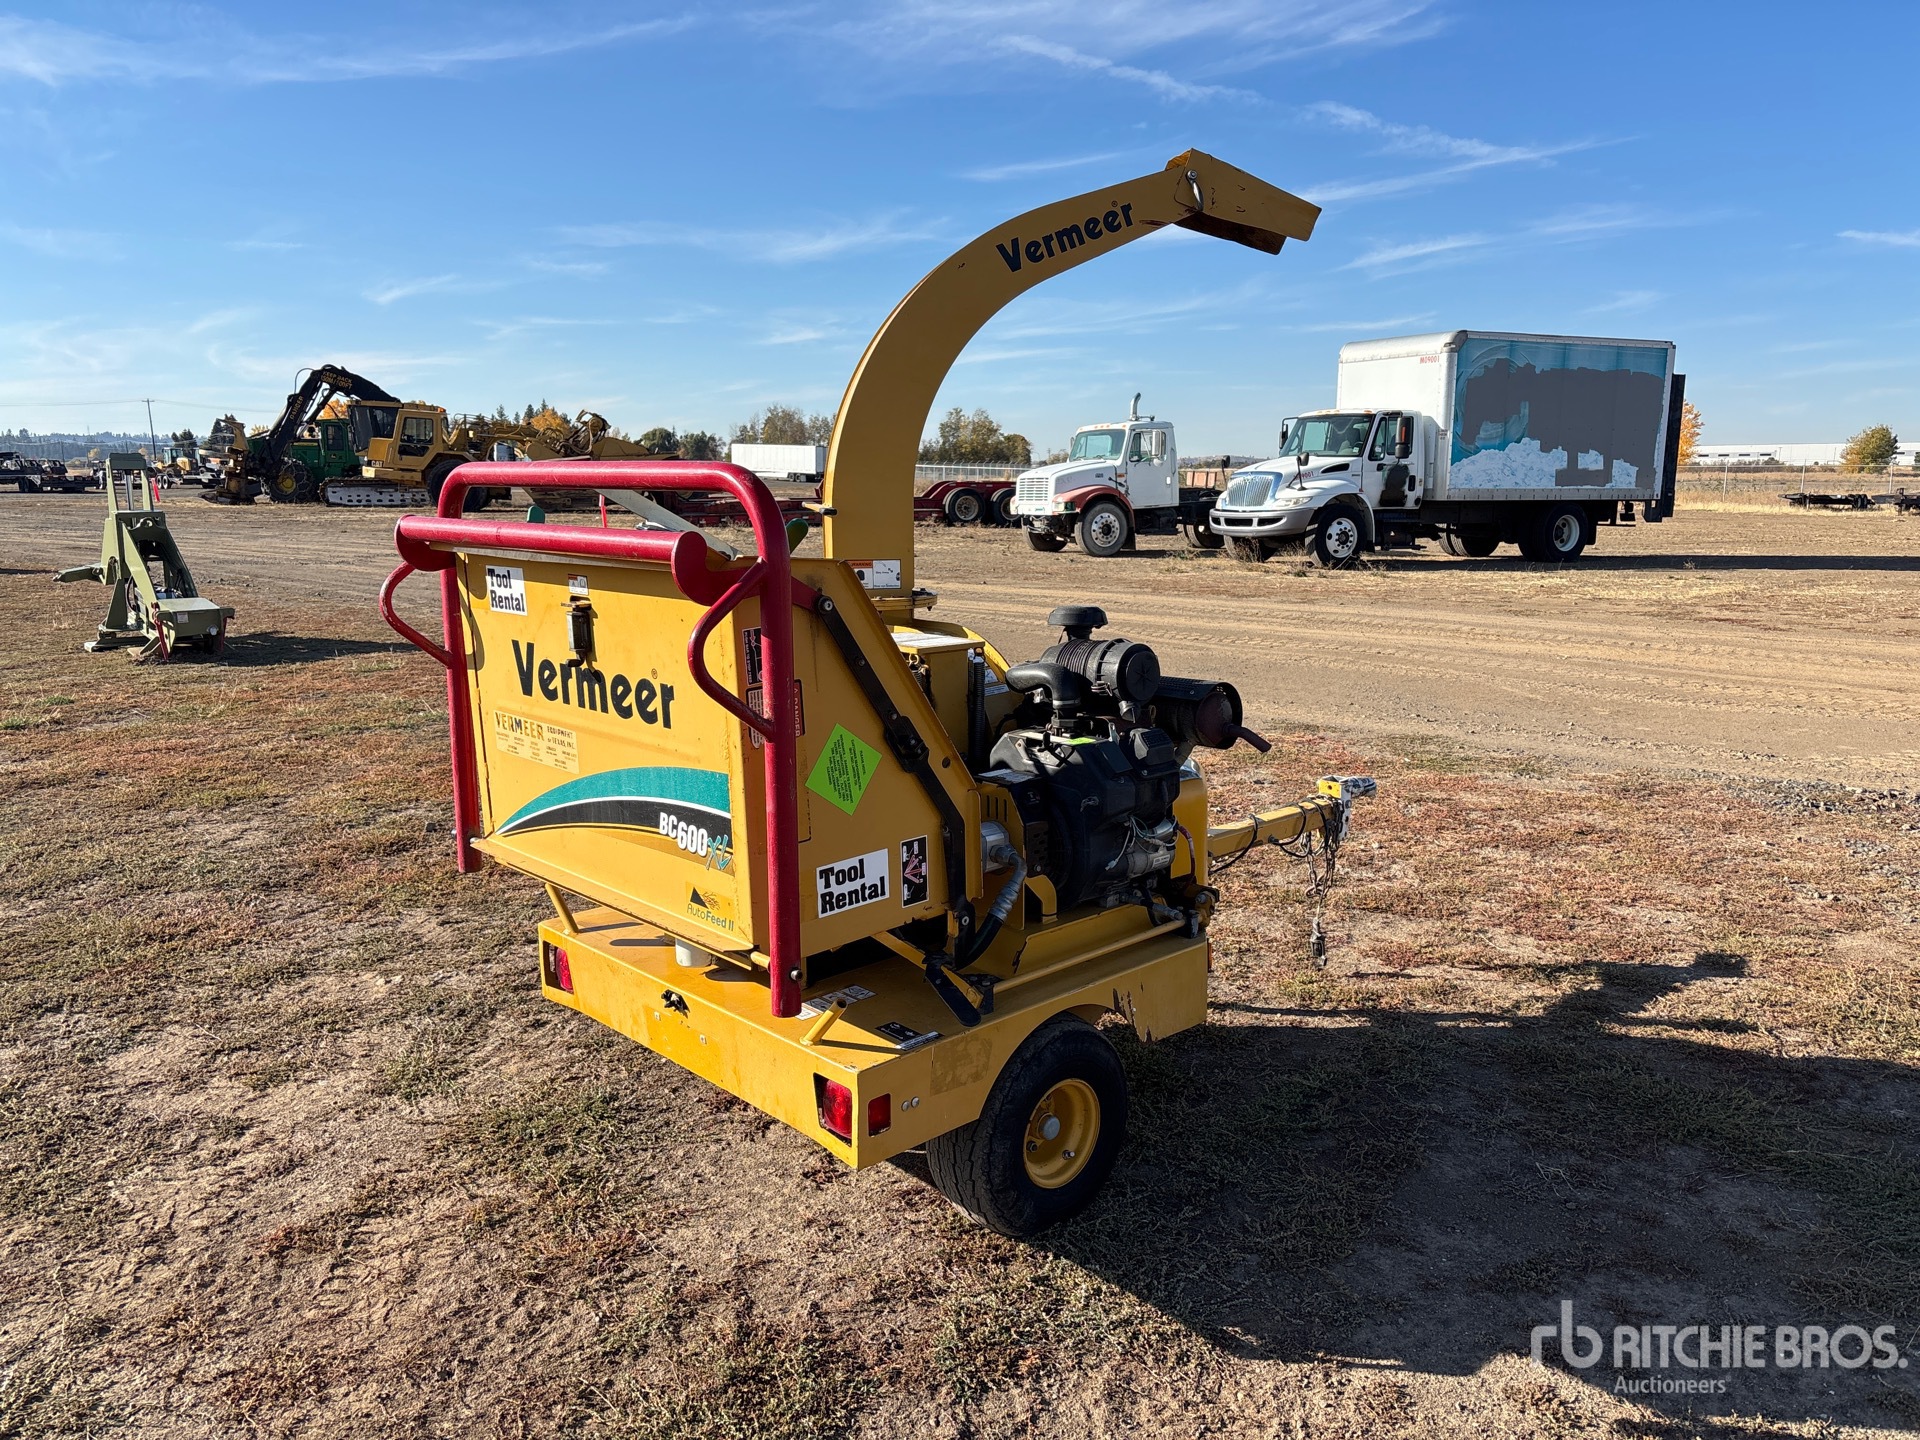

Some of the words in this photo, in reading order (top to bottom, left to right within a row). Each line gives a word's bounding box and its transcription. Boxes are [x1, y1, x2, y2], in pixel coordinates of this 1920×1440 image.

[995, 202, 1134, 272] Vermeer
[290, 396, 304, 420] DANGER
[487, 568, 512, 590] Tool
[490, 590, 526, 614] Rental
[511, 639, 675, 729] Vermeer
[495, 712, 544, 741] VERMEER
[819, 858, 865, 889] Tool
[820, 878, 885, 914] Rental
[687, 903, 726, 929] AutoFeed
